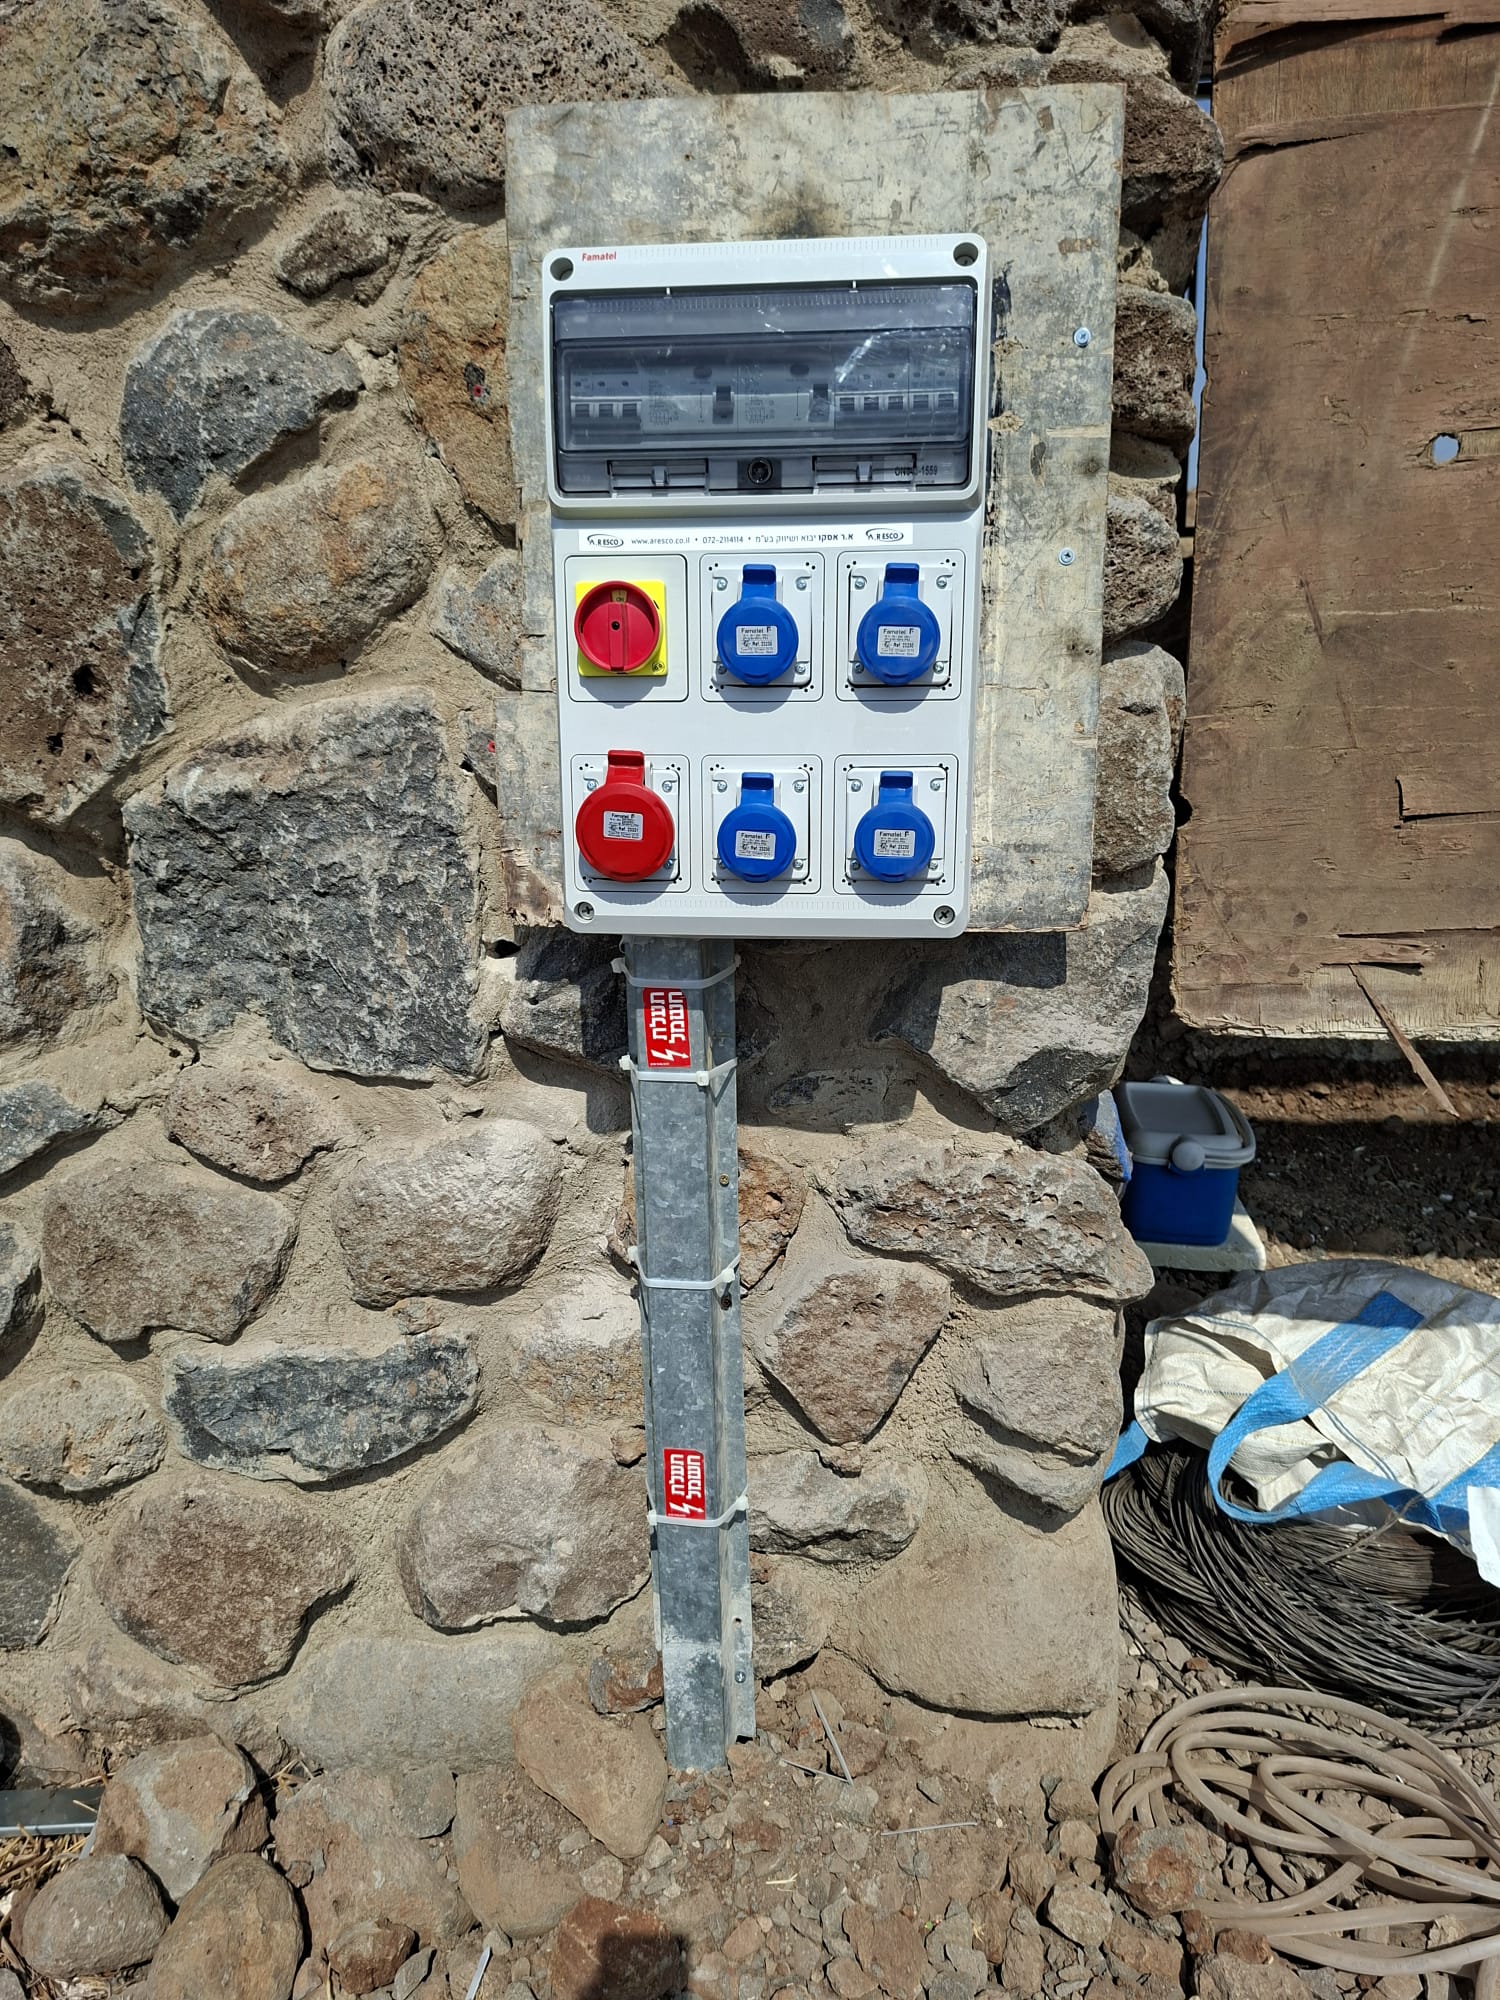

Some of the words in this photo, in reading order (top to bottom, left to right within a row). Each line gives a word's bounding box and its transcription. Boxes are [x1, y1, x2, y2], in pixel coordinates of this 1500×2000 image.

[582, 251, 617, 261] Famatel
[631, 537, 690, 545] www.aresco.co.il
[702, 535, 744, 544] 072-2114114
[818, 534, 839, 542] אסקו
[649, 991, 667, 1041] תעלת
[668, 991, 686, 1044] חשמל
[669, 1453, 685, 1496] תעלת
[686, 1454, 702, 1500] חשמל
